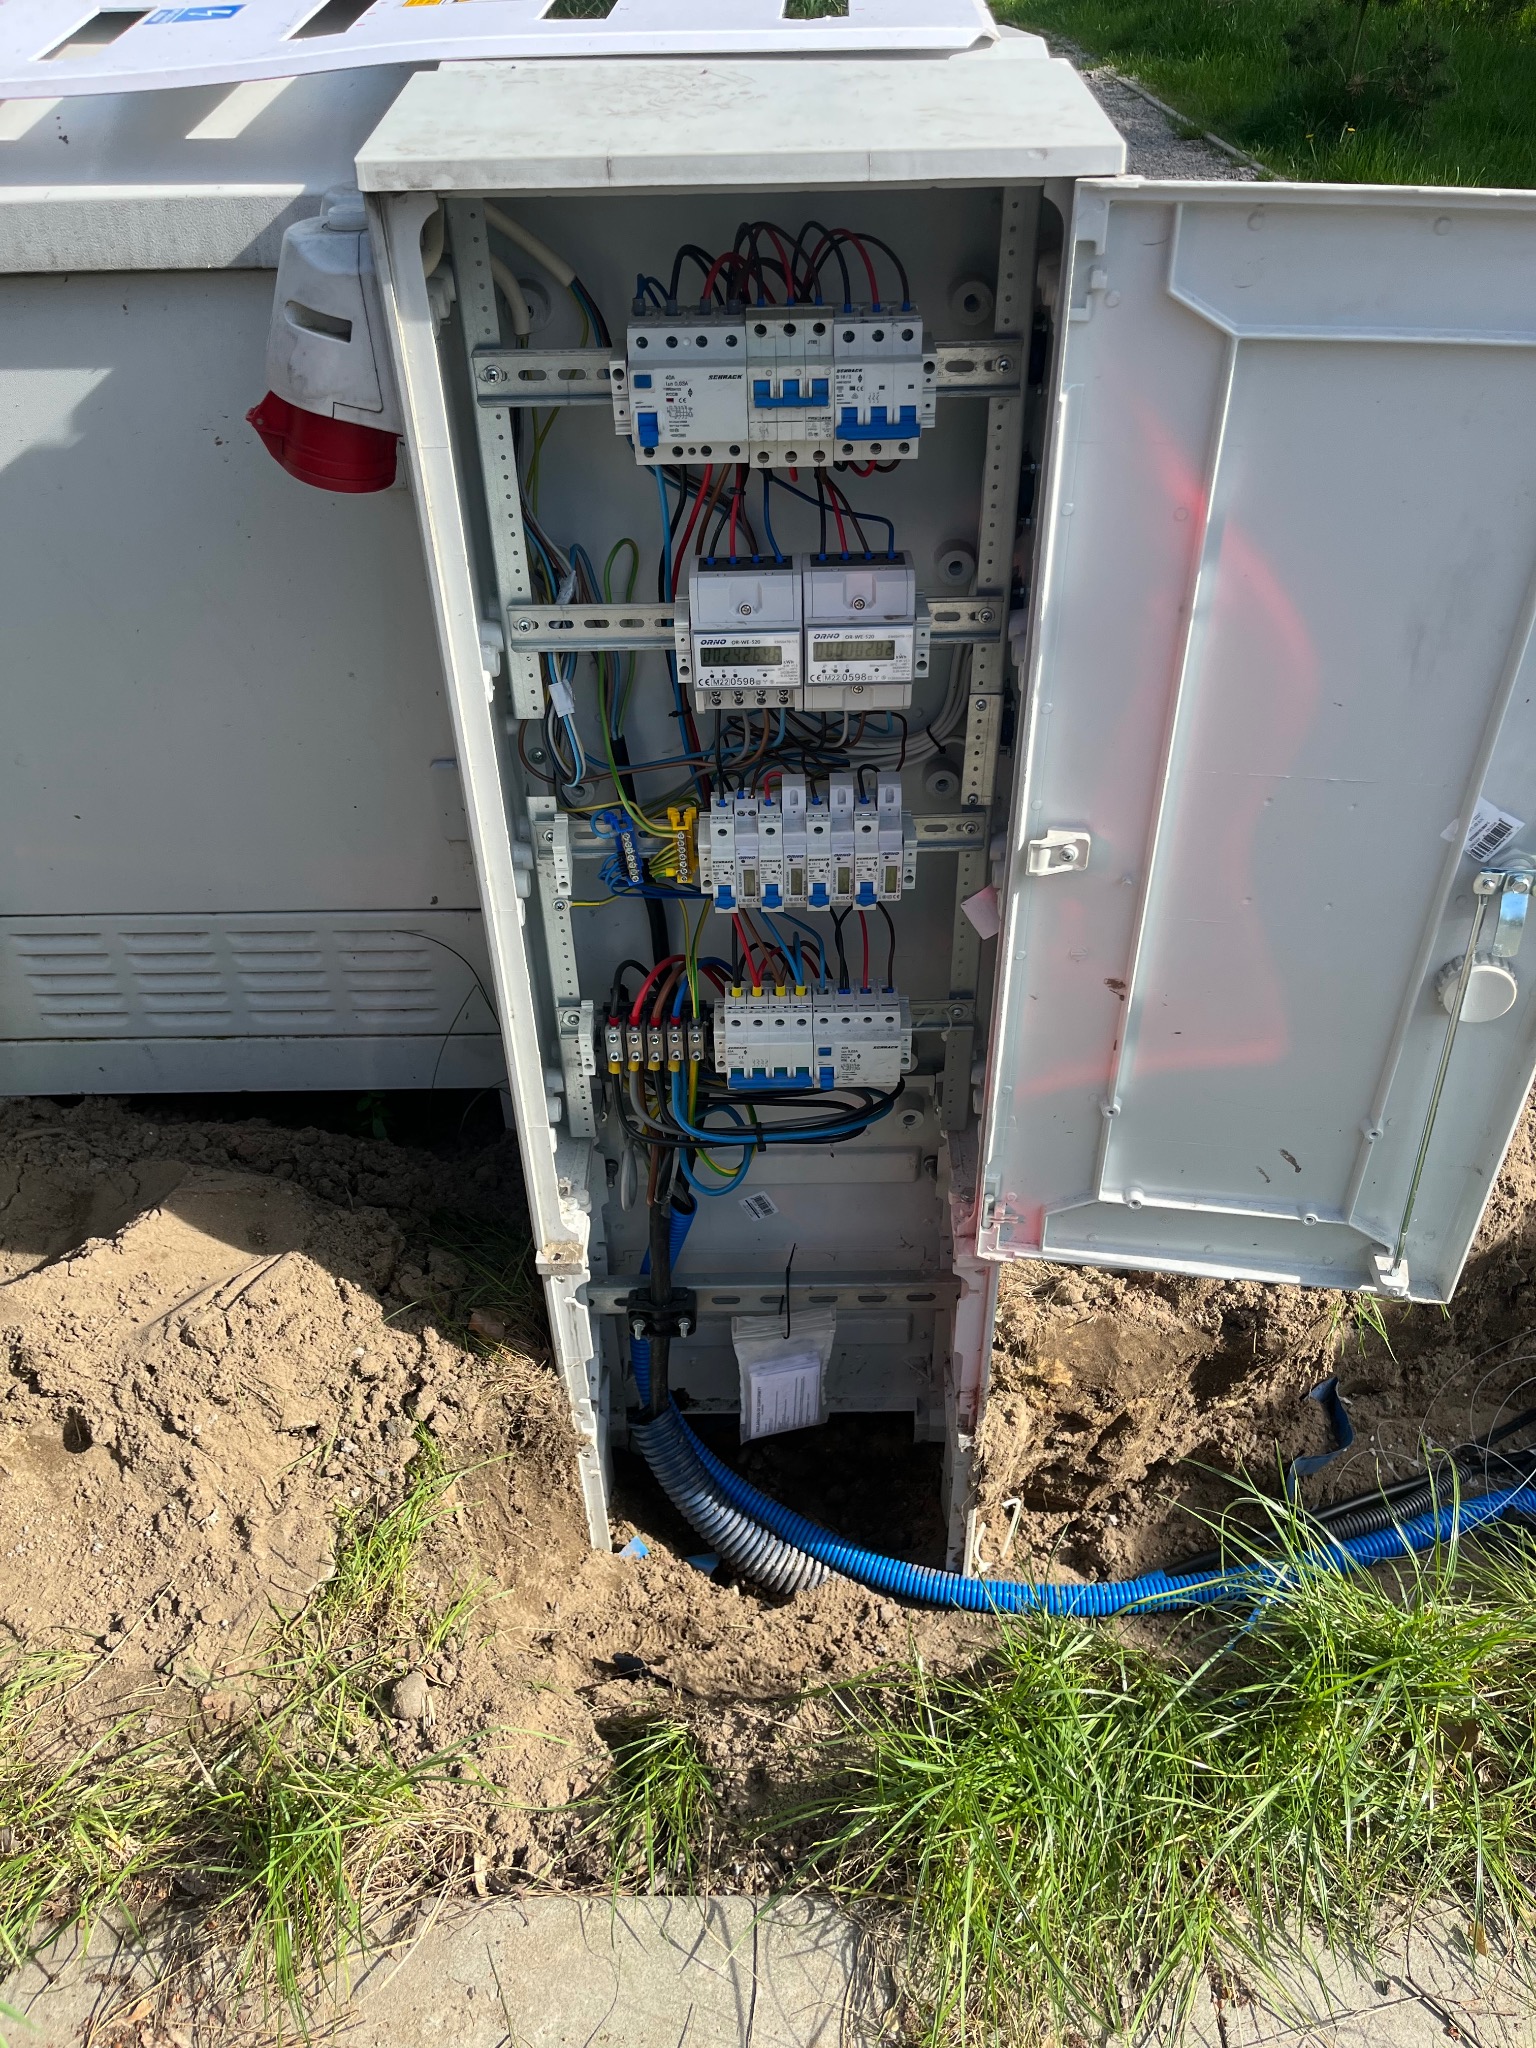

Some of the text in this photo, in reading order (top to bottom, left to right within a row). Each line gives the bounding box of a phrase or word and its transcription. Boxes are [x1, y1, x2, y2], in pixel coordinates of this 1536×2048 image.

[842, 673, 867, 681] 0598
[698, 678, 710, 686] CE
[730, 678, 755, 686] 0598
